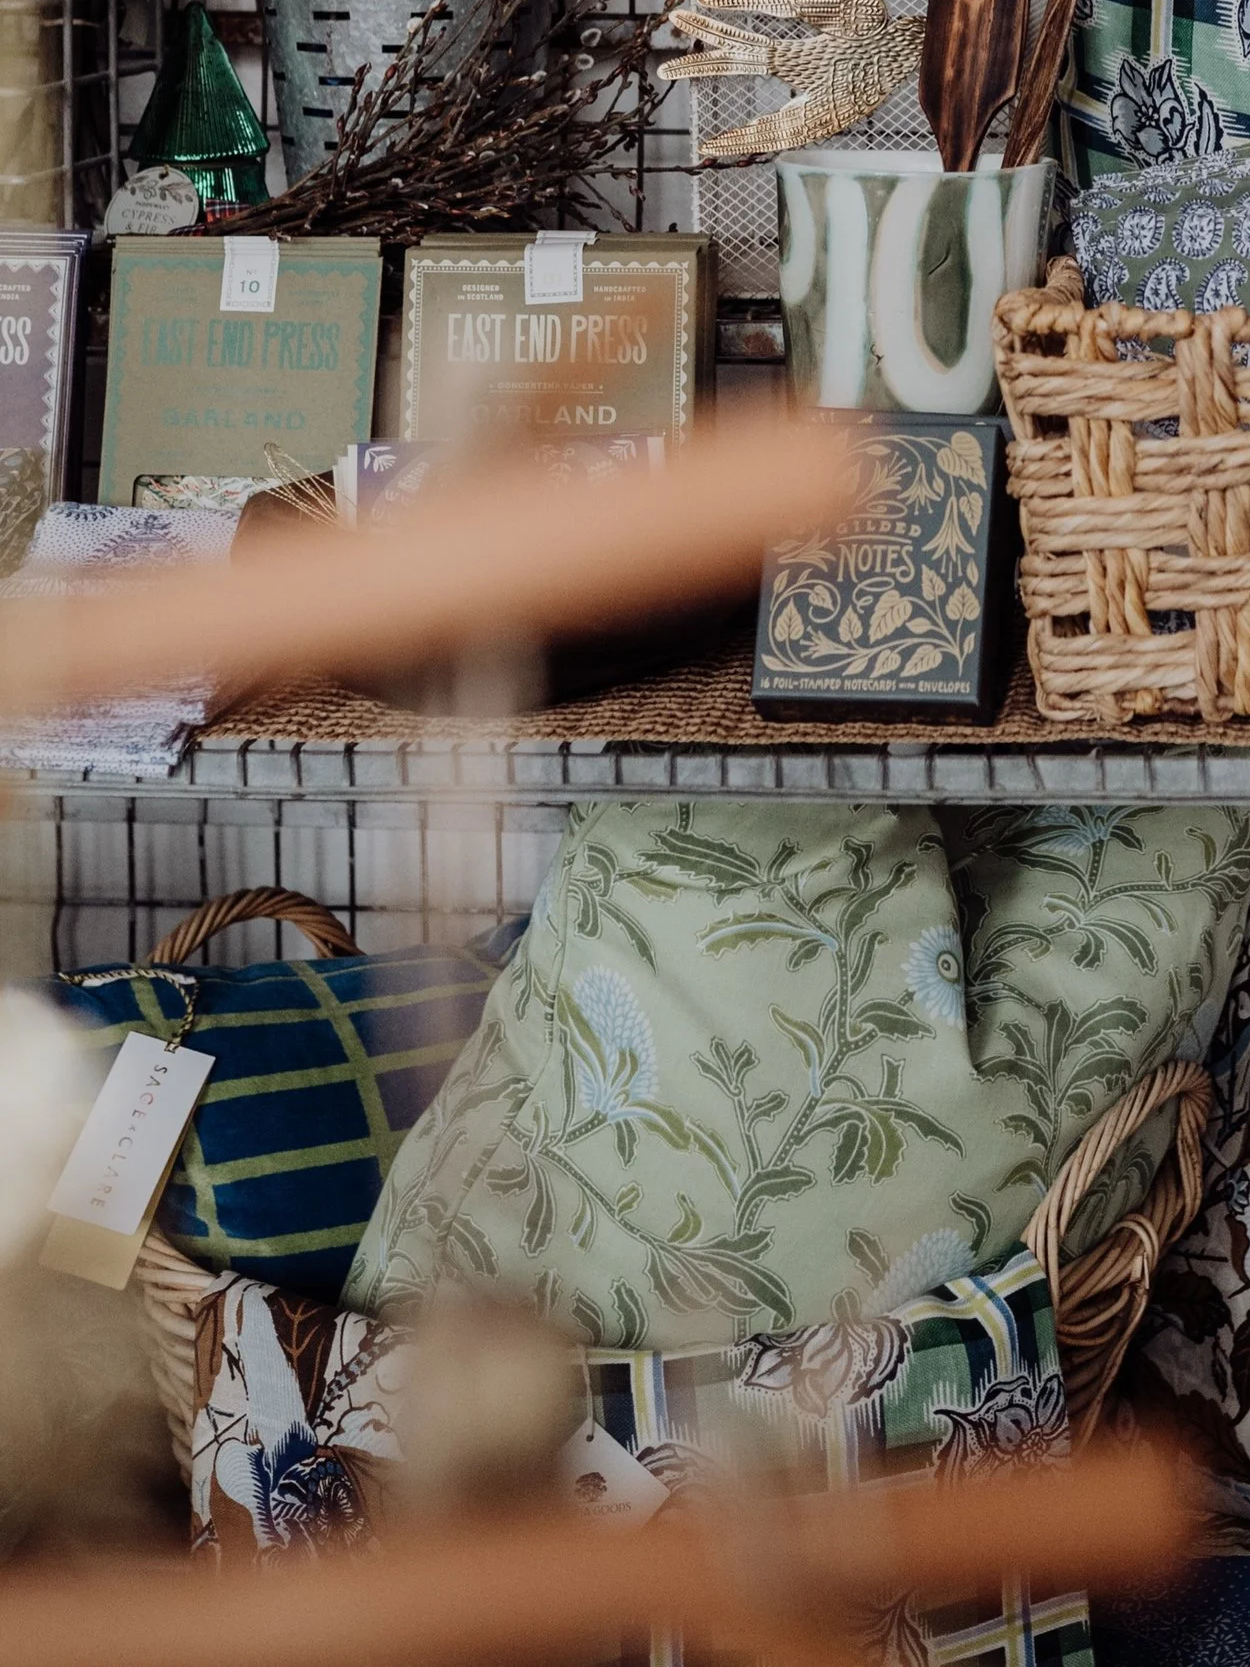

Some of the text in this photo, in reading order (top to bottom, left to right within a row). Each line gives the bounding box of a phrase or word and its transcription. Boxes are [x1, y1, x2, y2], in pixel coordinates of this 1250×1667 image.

[121, 208, 177, 225] CYPRESS
[138, 222, 158, 235] FIR
[240, 280, 260, 293] 10
[461, 284, 500, 292] DESIGNED
[593, 285, 647, 293] HANDCRAFTED
[466, 293, 504, 301] SCOTLAND
[0, 316, 31, 365] SS
[141, 318, 341, 371] EAST END PRESS
[447, 313, 648, 365] EAST END PRESS
[836, 519, 922, 537] GILDED
[837, 543, 916, 584] NOTES
[760, 677, 770, 689] 16
[773, 677, 842, 691] FOIL-STAMPED
[844, 679, 897, 692] NOTECARDS
[918, 680, 970, 694] ENVELOPES
[90, 1136, 134, 1209] CLARE
